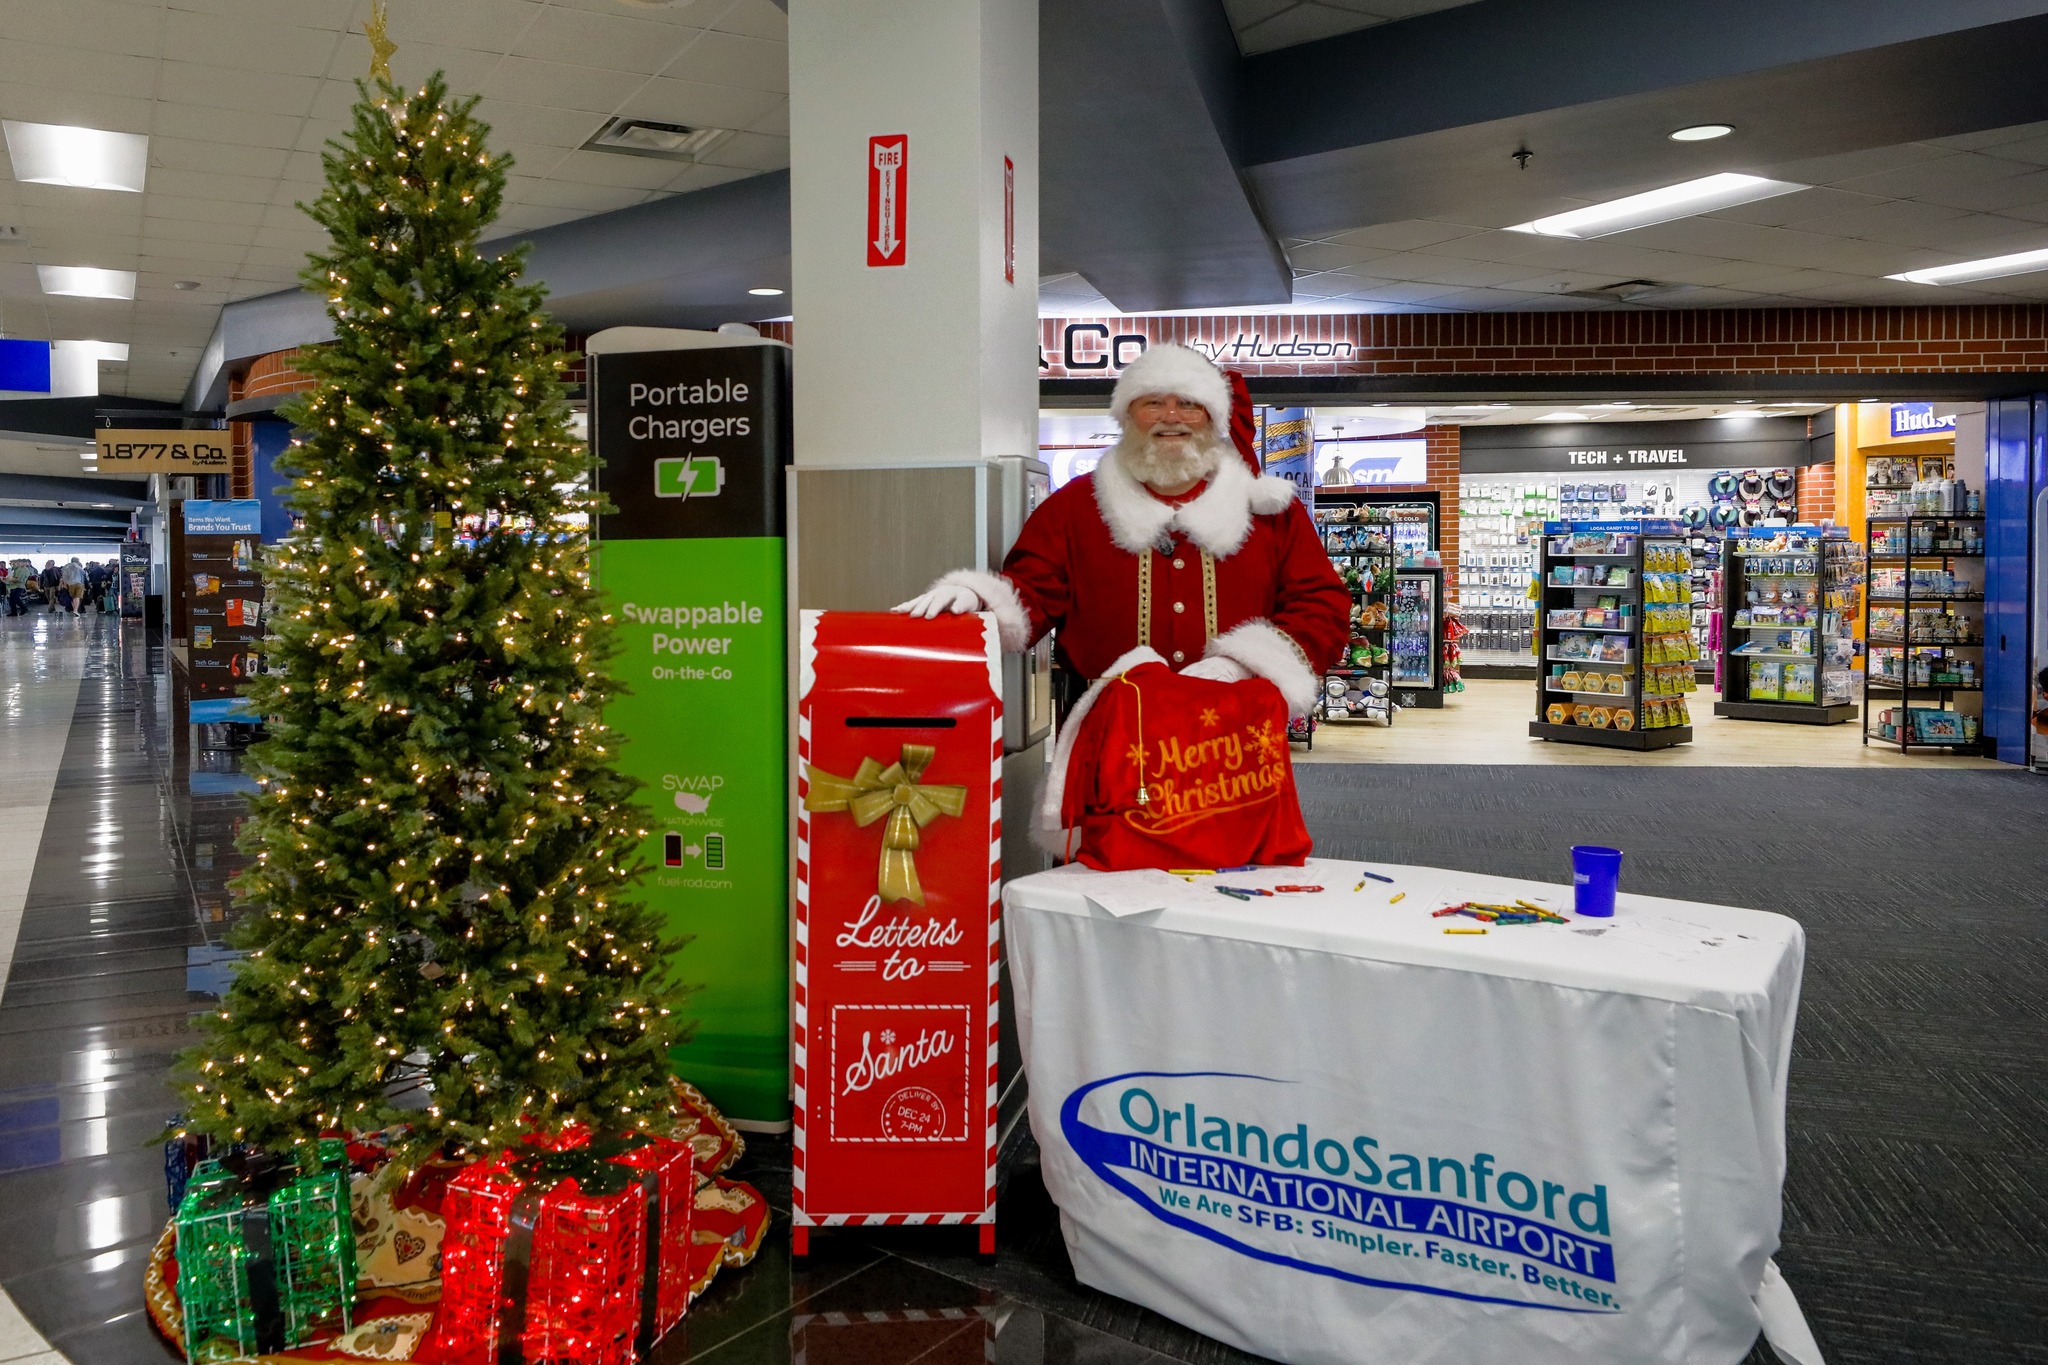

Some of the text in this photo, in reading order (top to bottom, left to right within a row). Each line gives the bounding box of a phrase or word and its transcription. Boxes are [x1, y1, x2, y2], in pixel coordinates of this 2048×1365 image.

[879, 152, 898, 165] FIRE
[1192, 338, 1227, 361] by
[1232, 334, 1352, 357] Hudson
[630, 377, 749, 407] Portable
[629, 415, 750, 443] Chargers
[102, 443, 227, 459] 1877 & Co.
[1569, 450, 1687, 464] TECH + TRAVEL
[188, 523, 252, 531] Brands You Trust
[123, 554, 149, 565] Disney
[622, 601, 763, 629] Swappable
[652, 633, 732, 655] Power
[652, 666, 732, 680] On-the-Go
[1152, 733, 1243, 778] Merry
[662, 774, 724, 791] SWAP
[1146, 762, 1286, 819] Christmas
[663, 817, 724, 827] NATIONWIDE
[658, 876, 732, 889] fuel-rod.com
[836, 894, 963, 948] Letters
[882, 950, 925, 981] to
[842, 1028, 954, 1096] Santa
[898, 1090, 940, 1111] DELIVER BY
[897, 1105, 931, 1123] DEC 24
[900, 1120, 923, 1134] 7-PM
[1130, 1140, 1600, 1275] INTERNATIONAL AIRPORT
[1159, 1186, 1621, 1310] We Are SFB: Simpler. Faster. Better.
